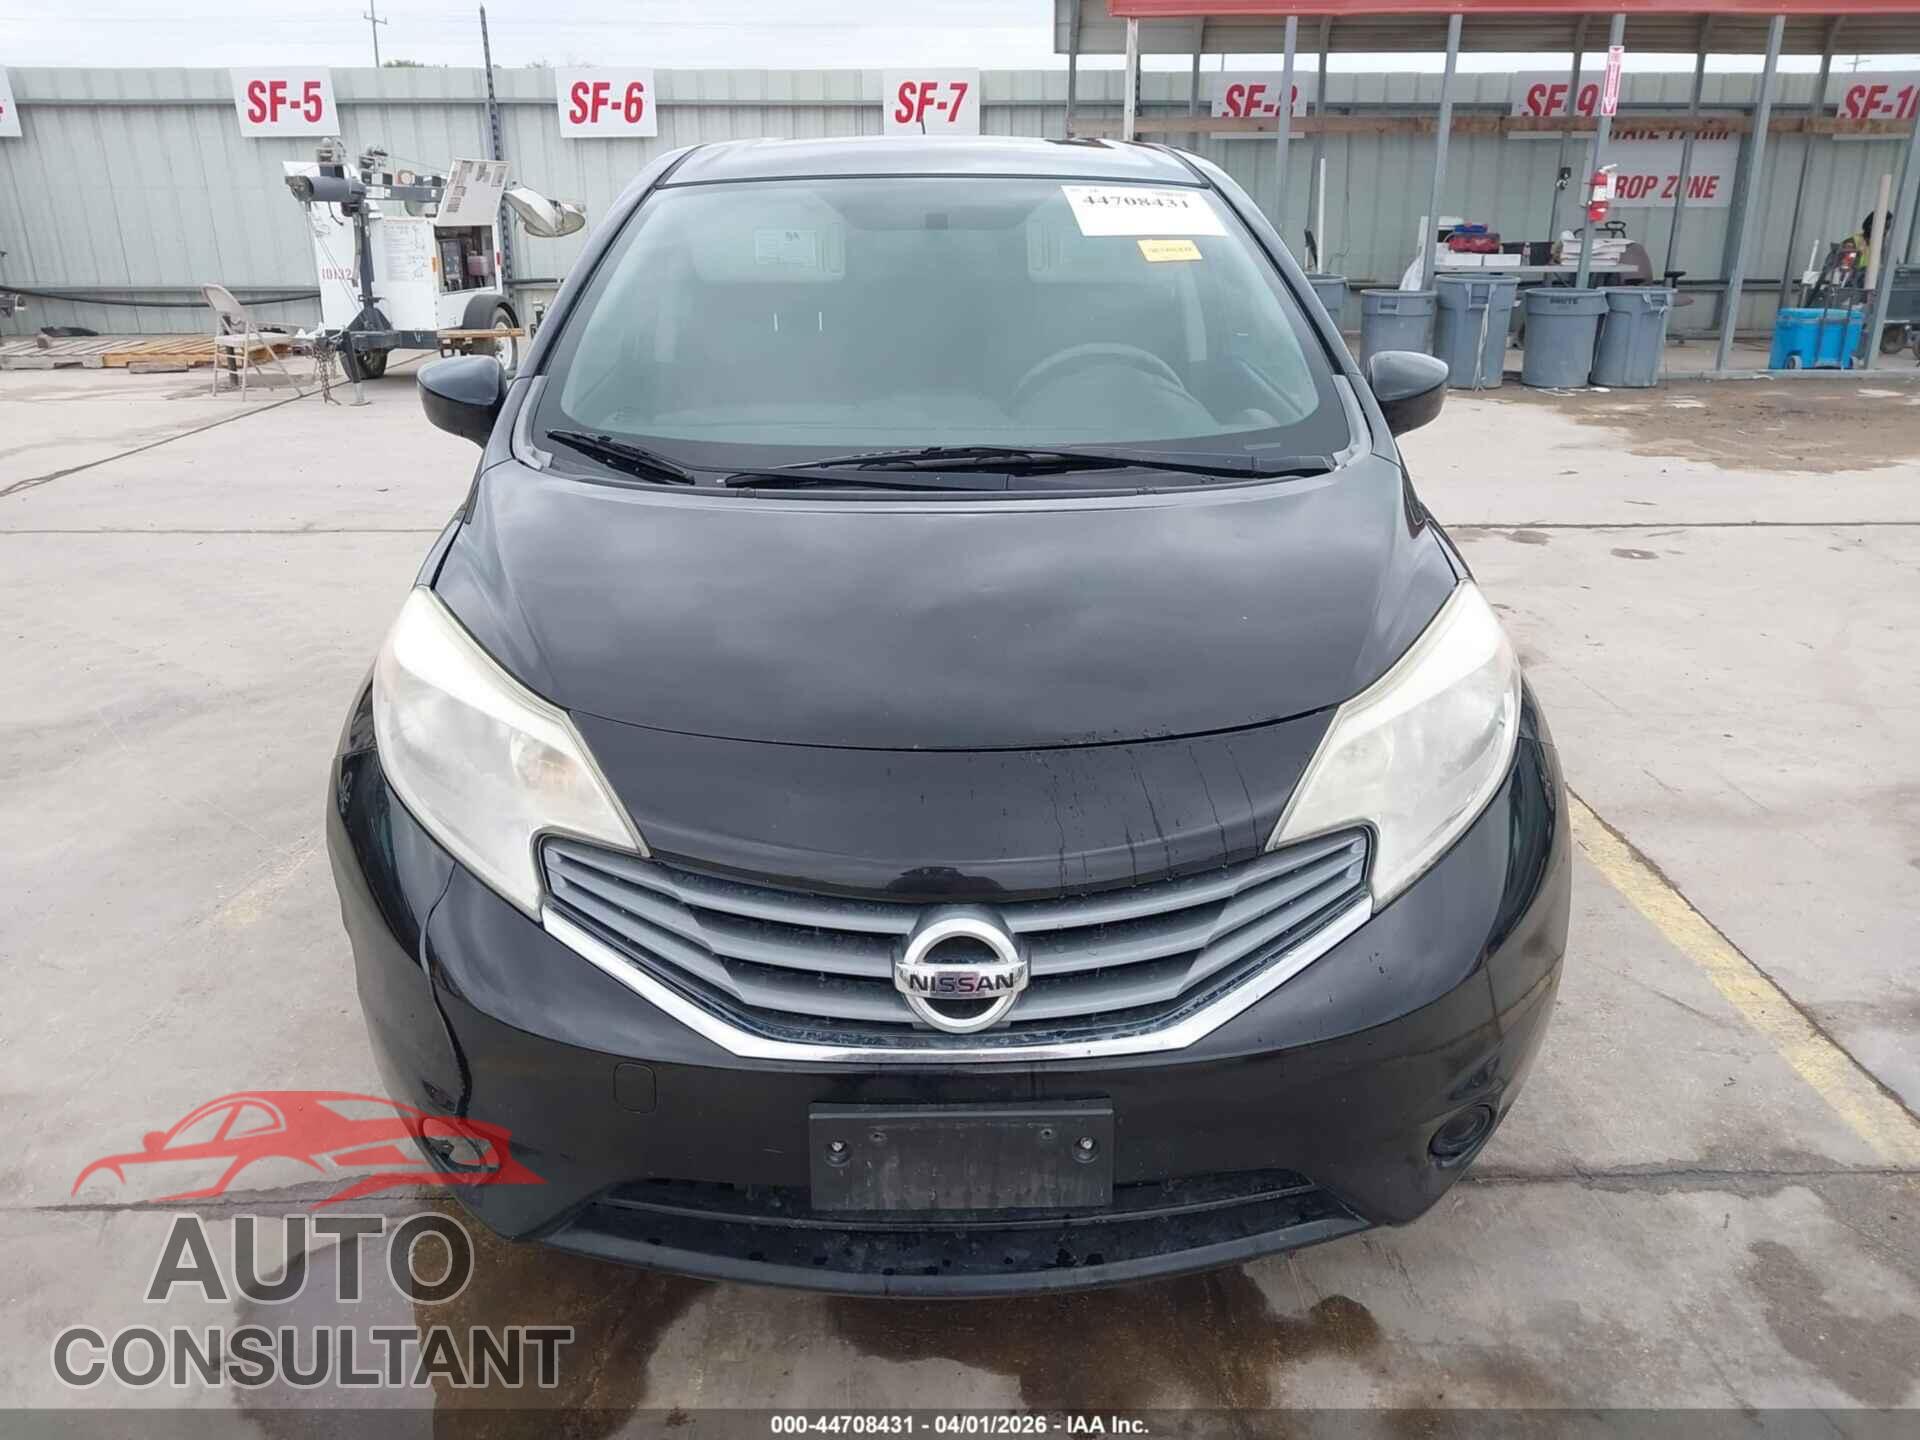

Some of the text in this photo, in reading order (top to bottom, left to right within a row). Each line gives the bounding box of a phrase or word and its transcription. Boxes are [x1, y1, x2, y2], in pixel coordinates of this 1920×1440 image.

[247, 80, 322, 123] SF-5
[569, 81, 644, 124] SF-6
[895, 81, 968, 123] SF-7
[1083, 195, 1188, 208] 44708431
[1614, 175, 1720, 198] ROP ZNE
[909, 973, 1014, 992] NISSAN
